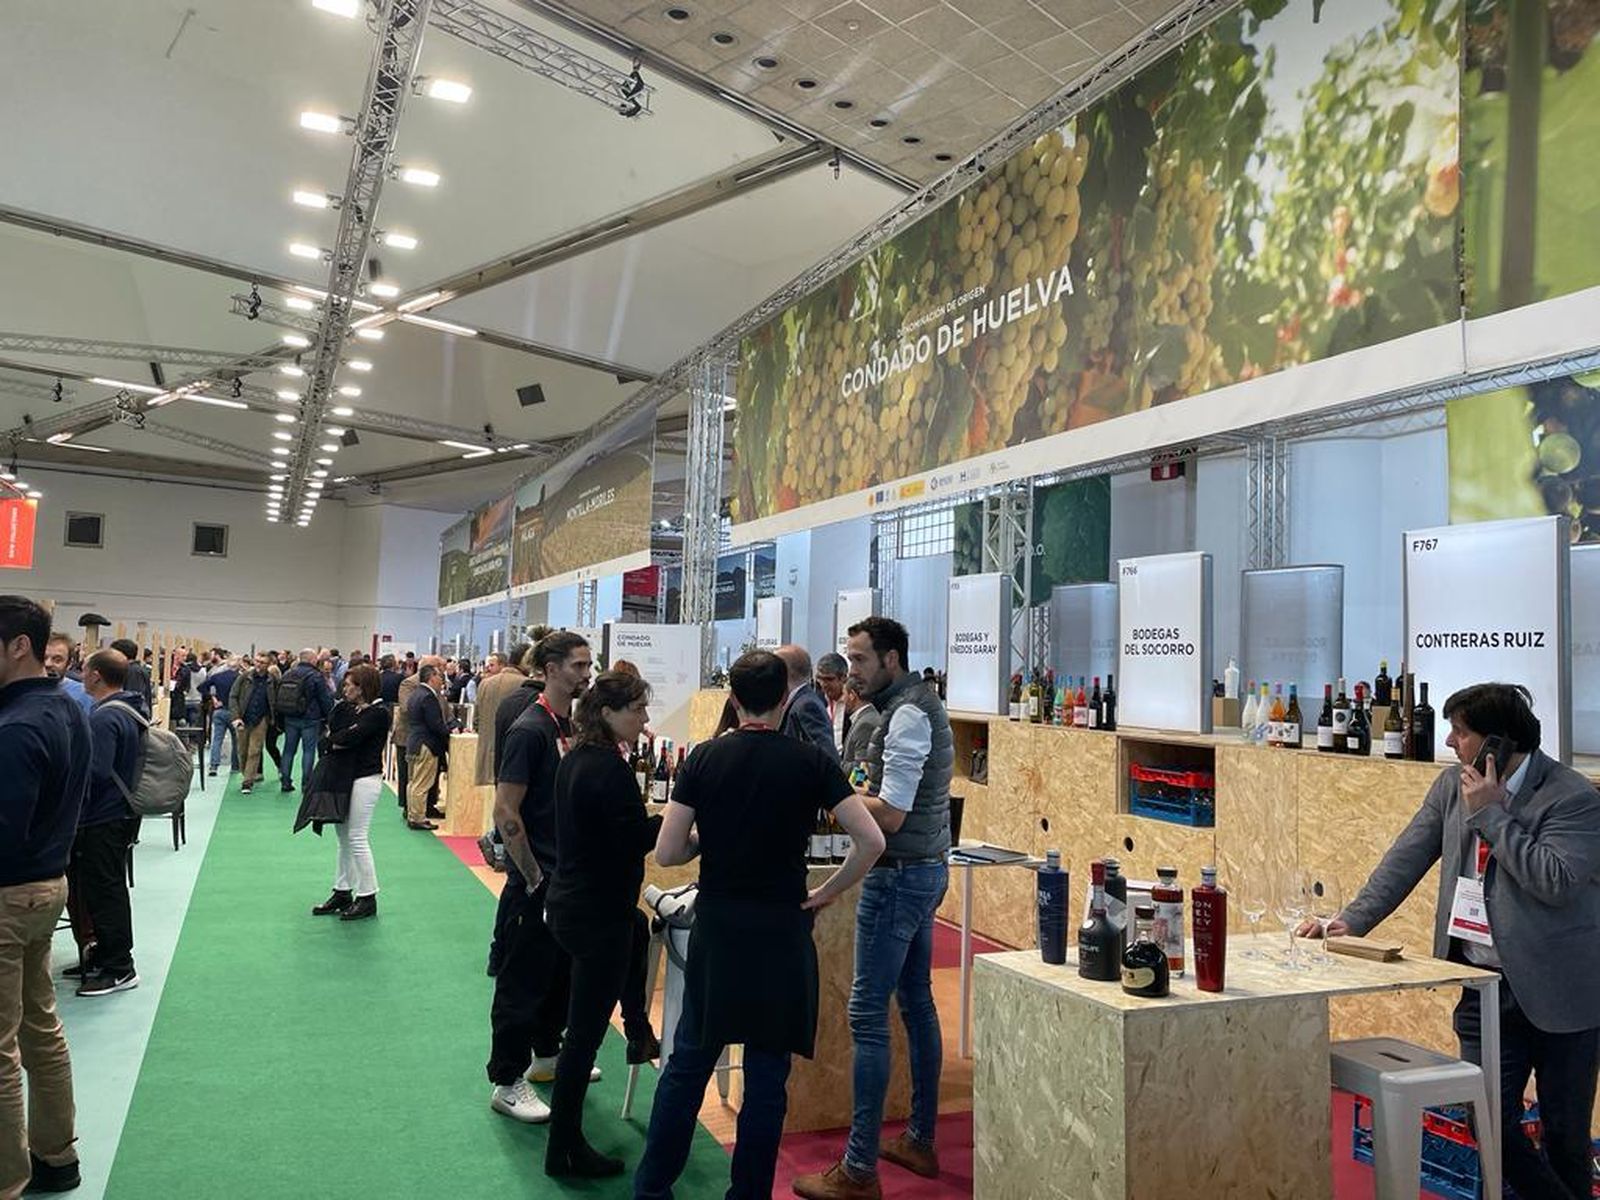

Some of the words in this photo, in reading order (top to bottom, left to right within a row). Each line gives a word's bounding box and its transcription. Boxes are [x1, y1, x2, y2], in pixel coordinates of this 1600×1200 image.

[946, 299, 957, 313] DE
[957, 283, 986, 307] ORIGEN
[841, 335, 931, 398] CONDADO
[937, 316, 966, 357] DE
[973, 264, 1075, 338] HUELVA
[1413, 538, 1438, 552] F767
[617, 634, 651, 642] CONDADO
[955, 632, 983, 642] BODEGAS
[1132, 628, 1180, 640] BODEGAS
[1416, 632, 1500, 648] CONTRERAS
[1504, 632, 1545, 648] RUIZ
[973, 644, 998, 654] GARAY
[1125, 644, 1139, 655] DEL
[1142, 643, 1195, 656] SOCORRO
